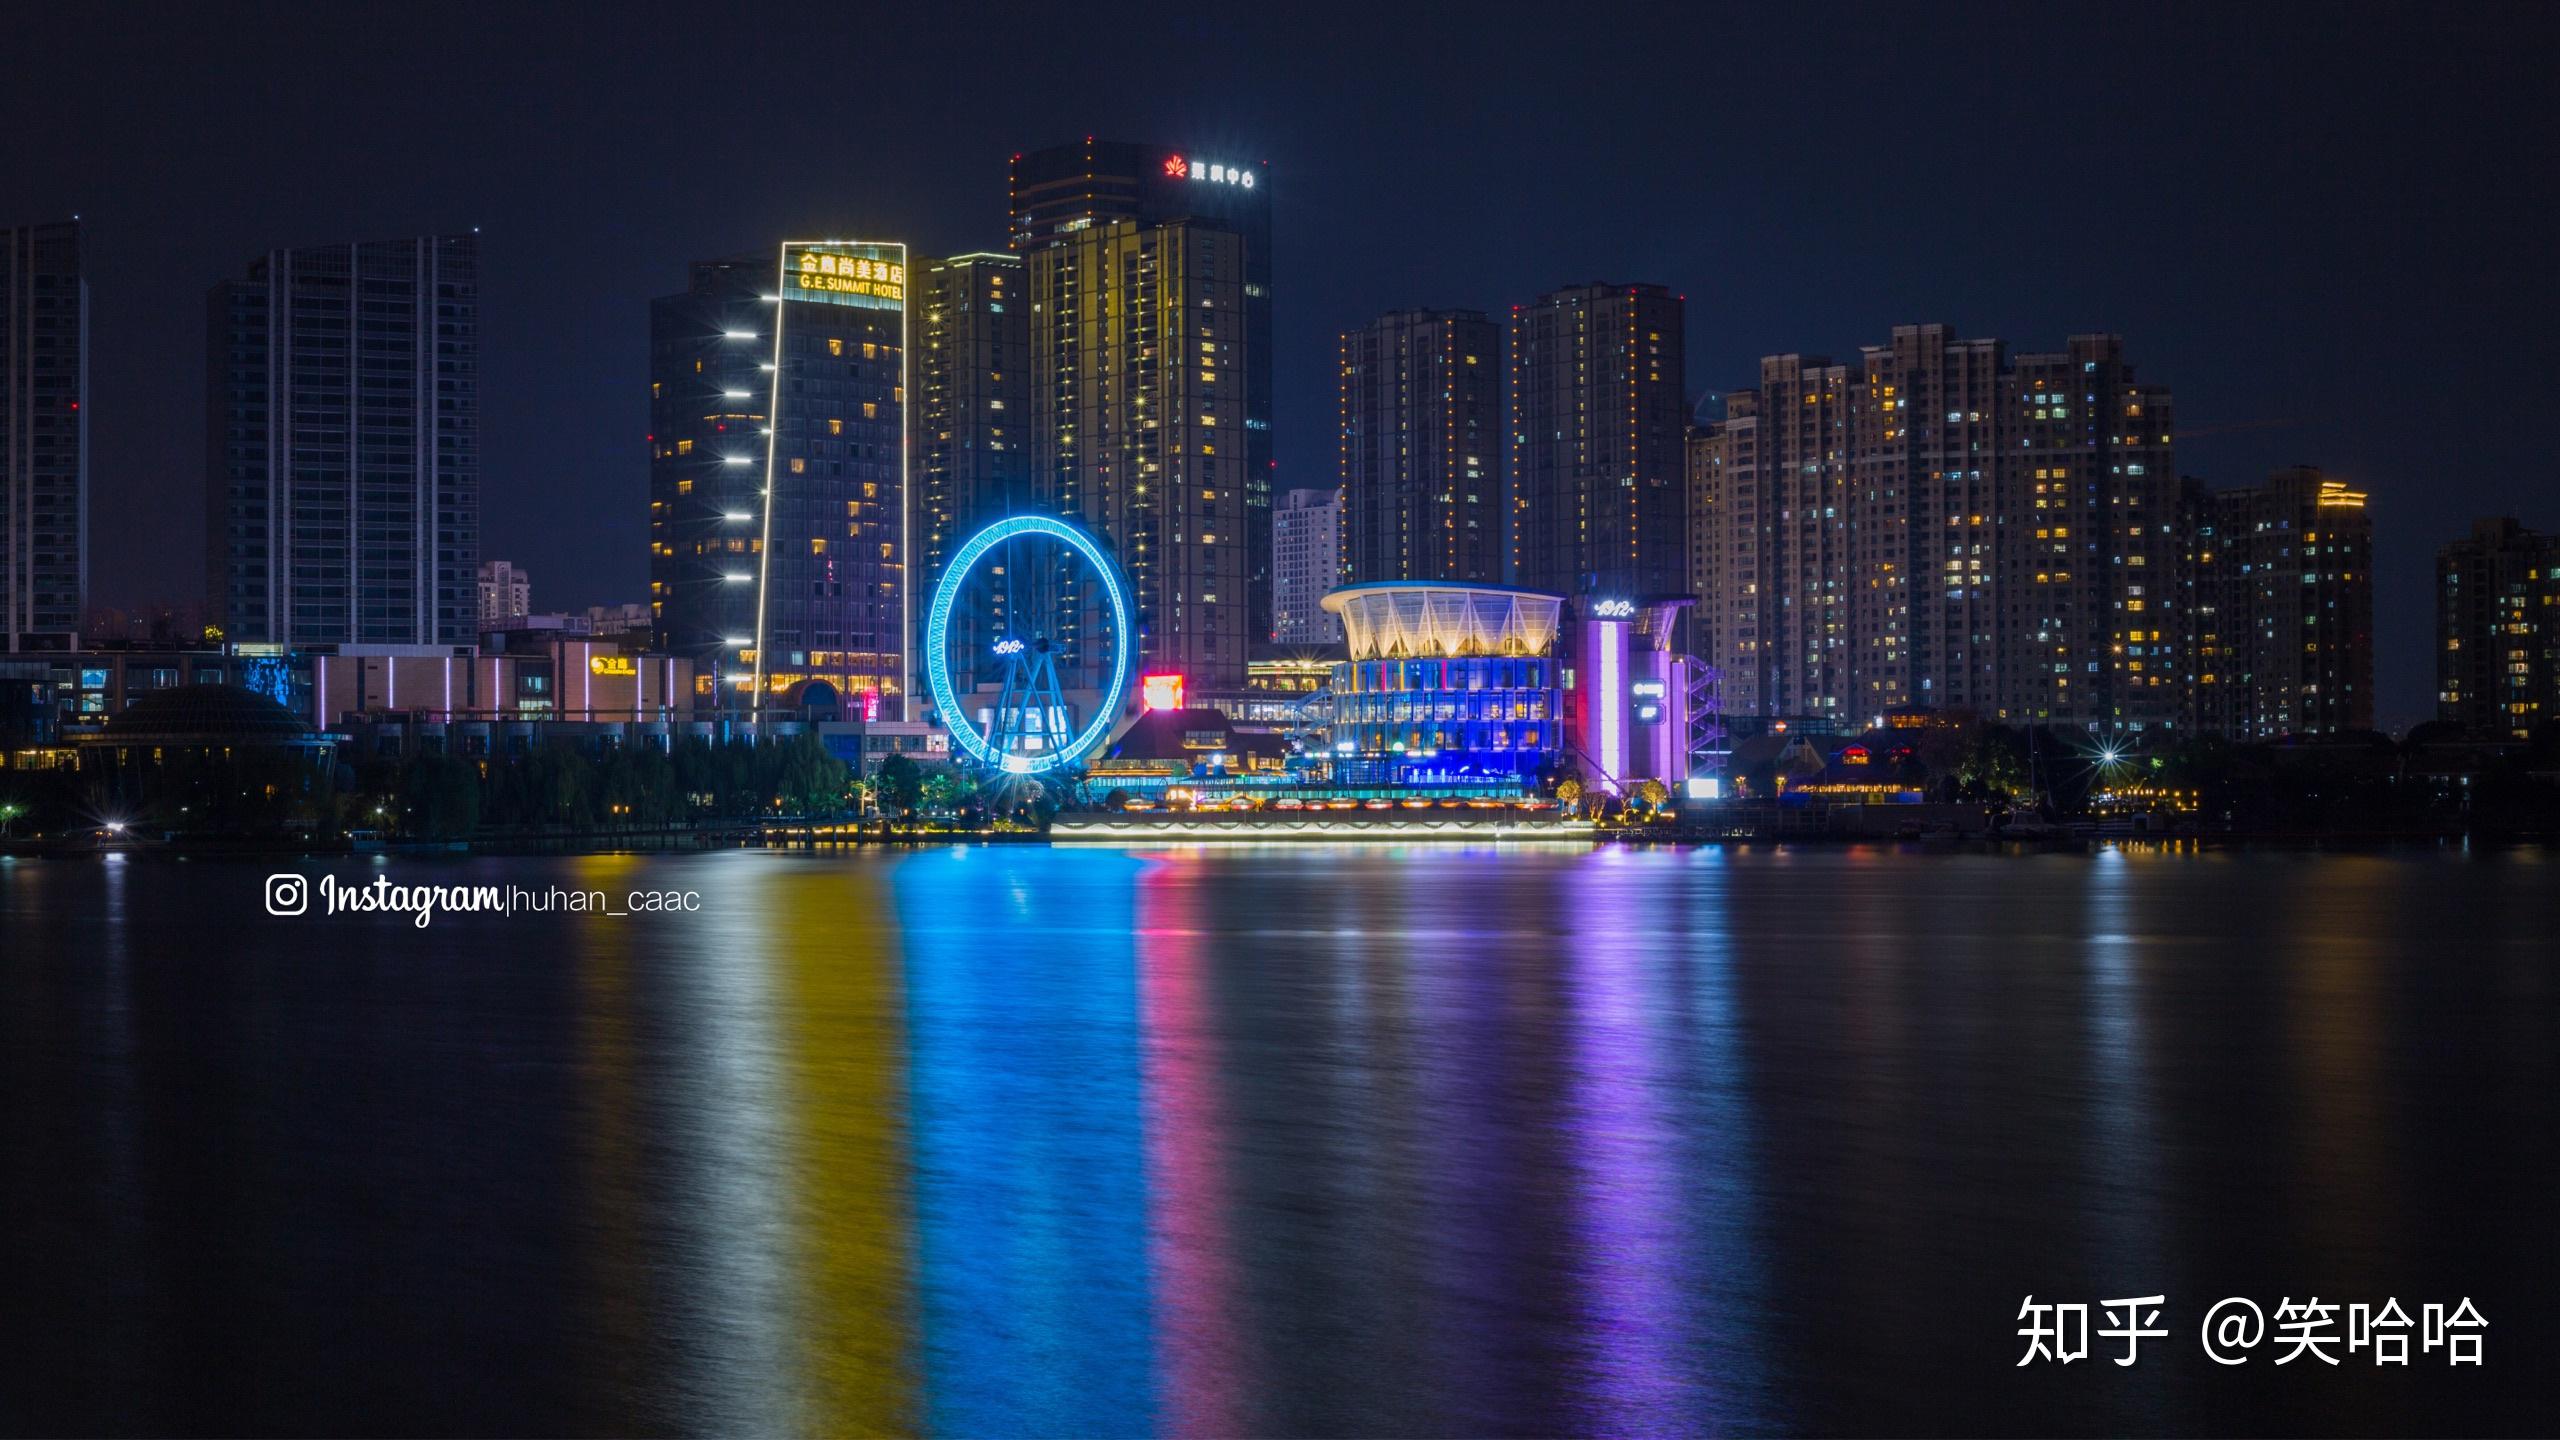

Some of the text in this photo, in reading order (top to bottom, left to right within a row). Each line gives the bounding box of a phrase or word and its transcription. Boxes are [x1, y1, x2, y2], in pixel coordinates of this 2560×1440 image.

[1190, 161, 1255, 189] 中心
[827, 278, 872, 295] SUMMIT
[873, 283, 903, 300] HOTEL
